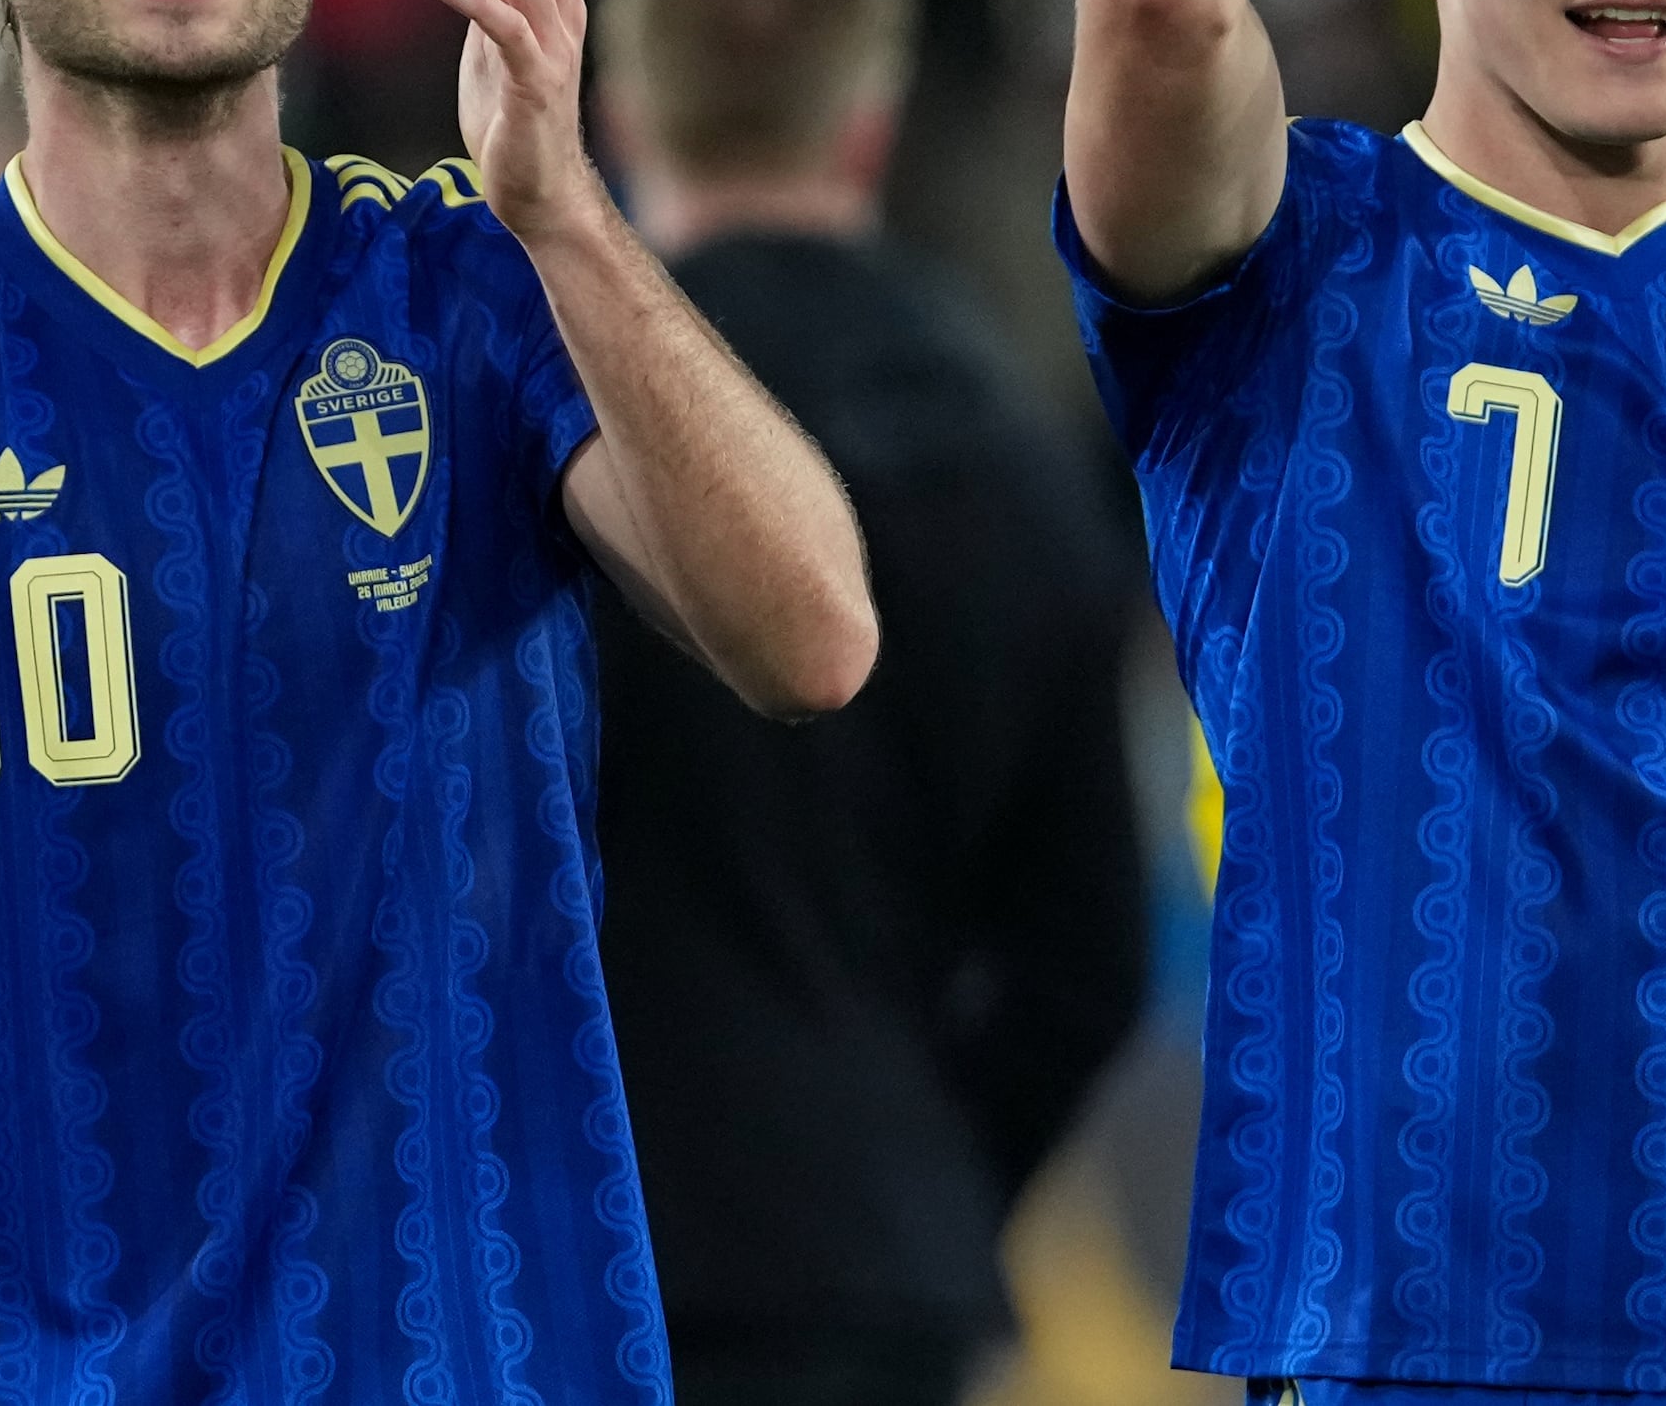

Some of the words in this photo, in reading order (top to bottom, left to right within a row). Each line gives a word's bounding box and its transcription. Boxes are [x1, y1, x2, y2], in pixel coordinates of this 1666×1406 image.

[316, 387, 404, 414] SVERIGE
[1447, 362, 1563, 588] 7
[348, 568, 389, 585] UKRAINE
[357, 586, 371, 599] 26
[373, 580, 408, 598] MARCH
